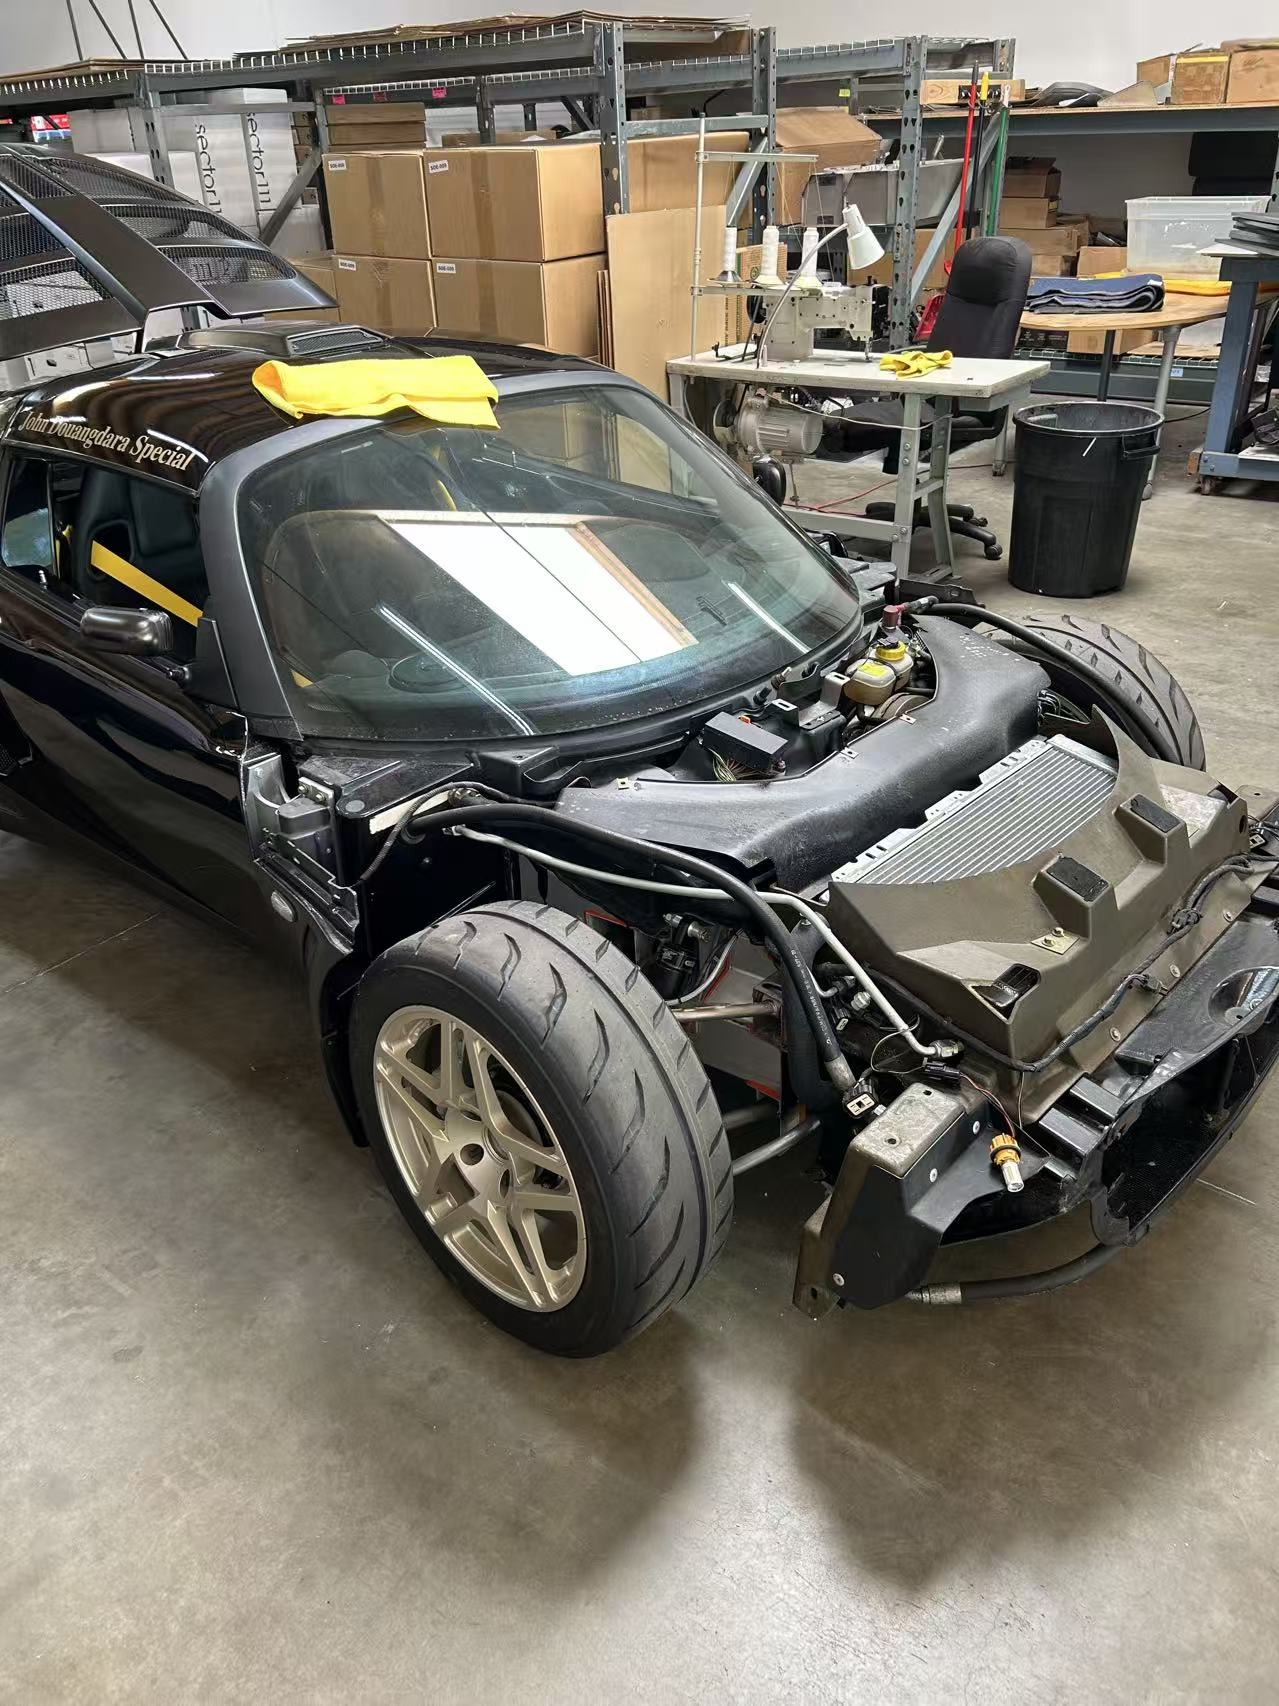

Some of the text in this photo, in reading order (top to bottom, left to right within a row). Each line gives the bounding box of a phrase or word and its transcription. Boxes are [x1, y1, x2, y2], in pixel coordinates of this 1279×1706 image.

[18, 411, 197, 471] John Douangdara Special
